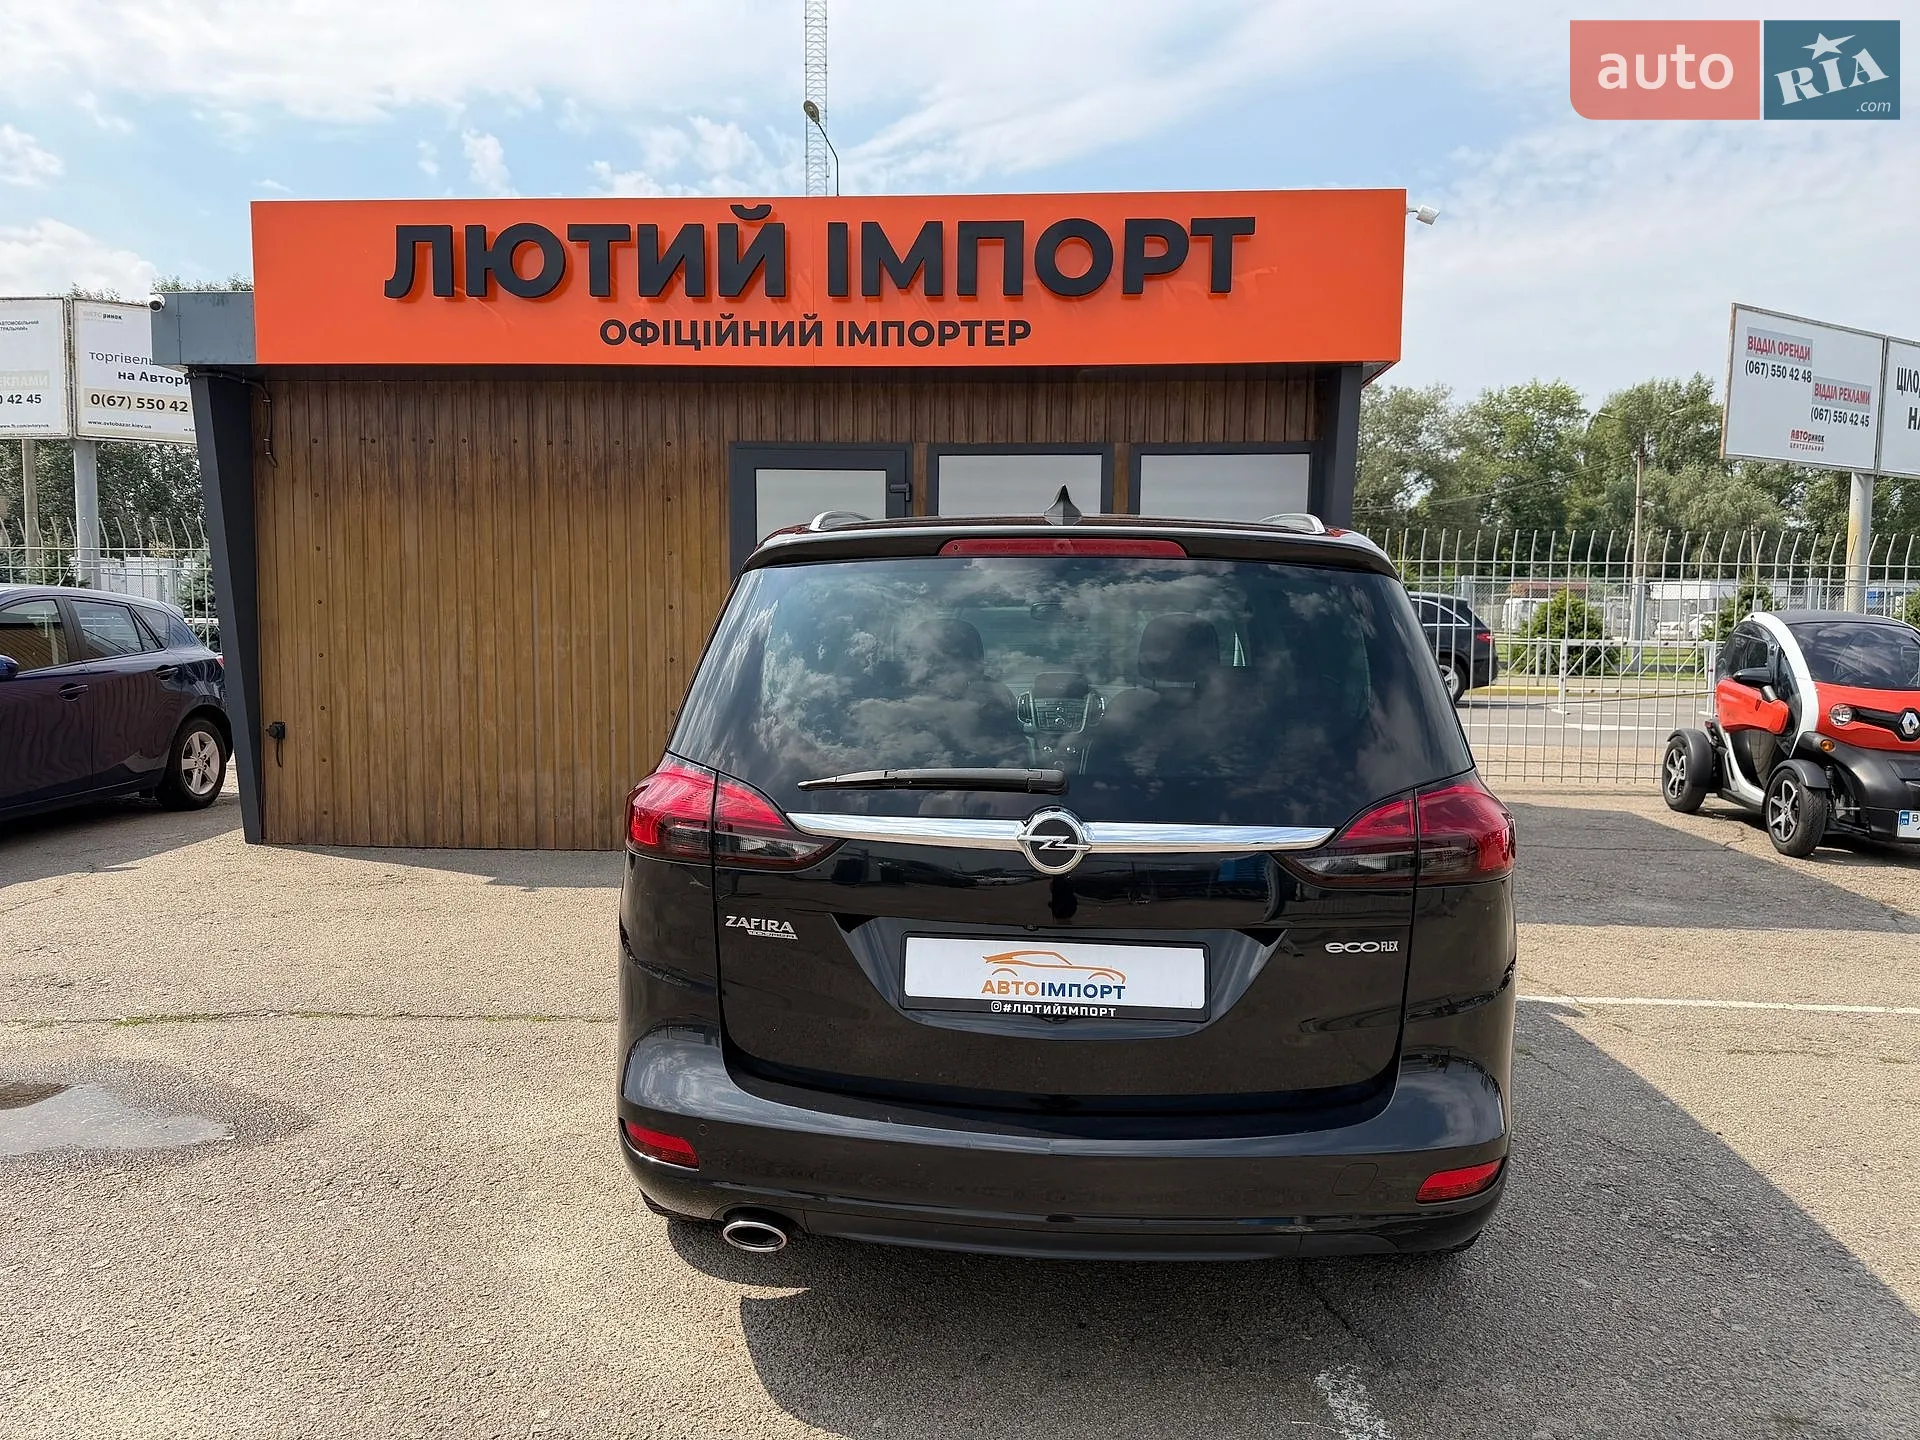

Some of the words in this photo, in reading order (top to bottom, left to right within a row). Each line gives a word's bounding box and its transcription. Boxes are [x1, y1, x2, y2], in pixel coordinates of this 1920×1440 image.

[384, 204, 787, 299] ЛЮТИЙ
[827, 216, 1256, 298] ІМПОРТ
[599, 313, 823, 351] ОФІЦІЙНИЙ
[836, 319, 1032, 348] ІМПОРТЕР
[1747, 335, 1776, 356] ВІДДІЛ
[1778, 341, 1811, 362] ОРЕНДИ
[118, 371, 135, 381] на
[1745, 359, 1769, 379] (067)
[1770, 364, 1788, 379] 550
[1789, 367, 1800, 381] 42
[1801, 370, 1812, 383] 48
[1896, 366, 1920, 397] ЦІЛО
[7, 394, 22, 404] 42
[26, 394, 42, 404] 45
[91, 393, 132, 410] 0(67)
[136, 397, 165, 411] 550
[169, 400, 188, 413] 42
[1814, 382, 1838, 402] ВІДДІЛ
[1839, 387, 1871, 406] РЕКЛАМИ
[1810, 406, 1832, 424] (067)
[1833, 410, 1848, 424] 550
[1849, 412, 1859, 426] 42
[1860, 414, 1870, 428] 45
[725, 915, 796, 933] ZAFIRA
[981, 979, 1126, 1000] АВТОІМПОРТ
[1003, 1003, 1117, 1018] #ЛЮТИЙІМПОРТ
